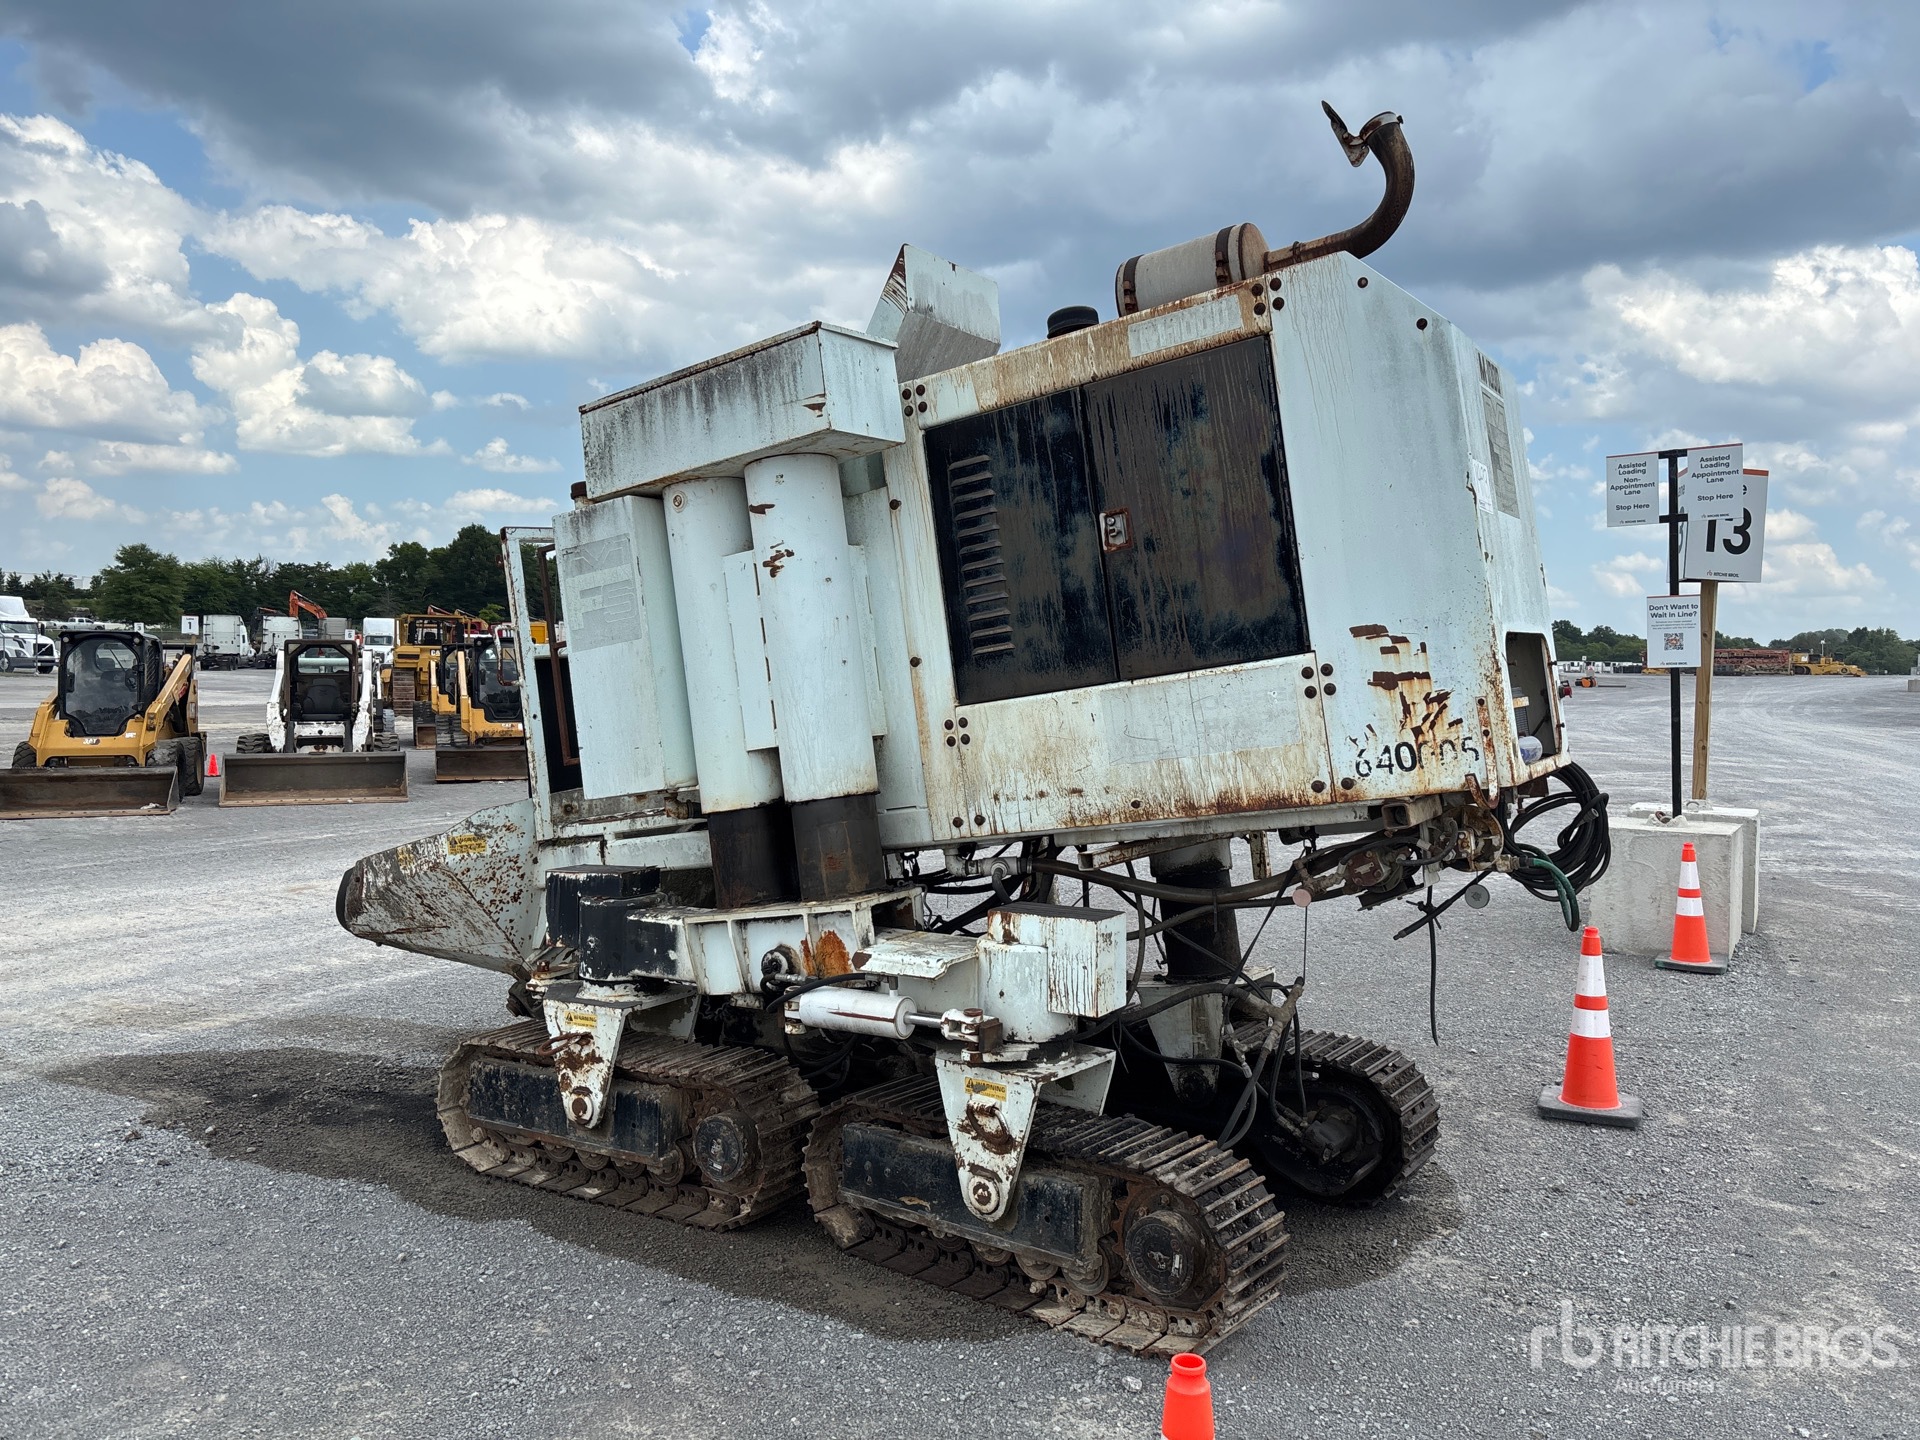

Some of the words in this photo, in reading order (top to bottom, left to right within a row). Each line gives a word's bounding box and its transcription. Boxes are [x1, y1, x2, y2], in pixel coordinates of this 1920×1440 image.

[1699, 454, 1731, 463] Assisted
[1617, 461, 1647, 469] Assisted
[1700, 461, 1730, 469] Loading
[1691, 469, 1739, 479] Appointment
[1610, 482, 1656, 491] Appointment
[1697, 494, 1715, 502] Stop
[187, 621, 192, 629] 1
